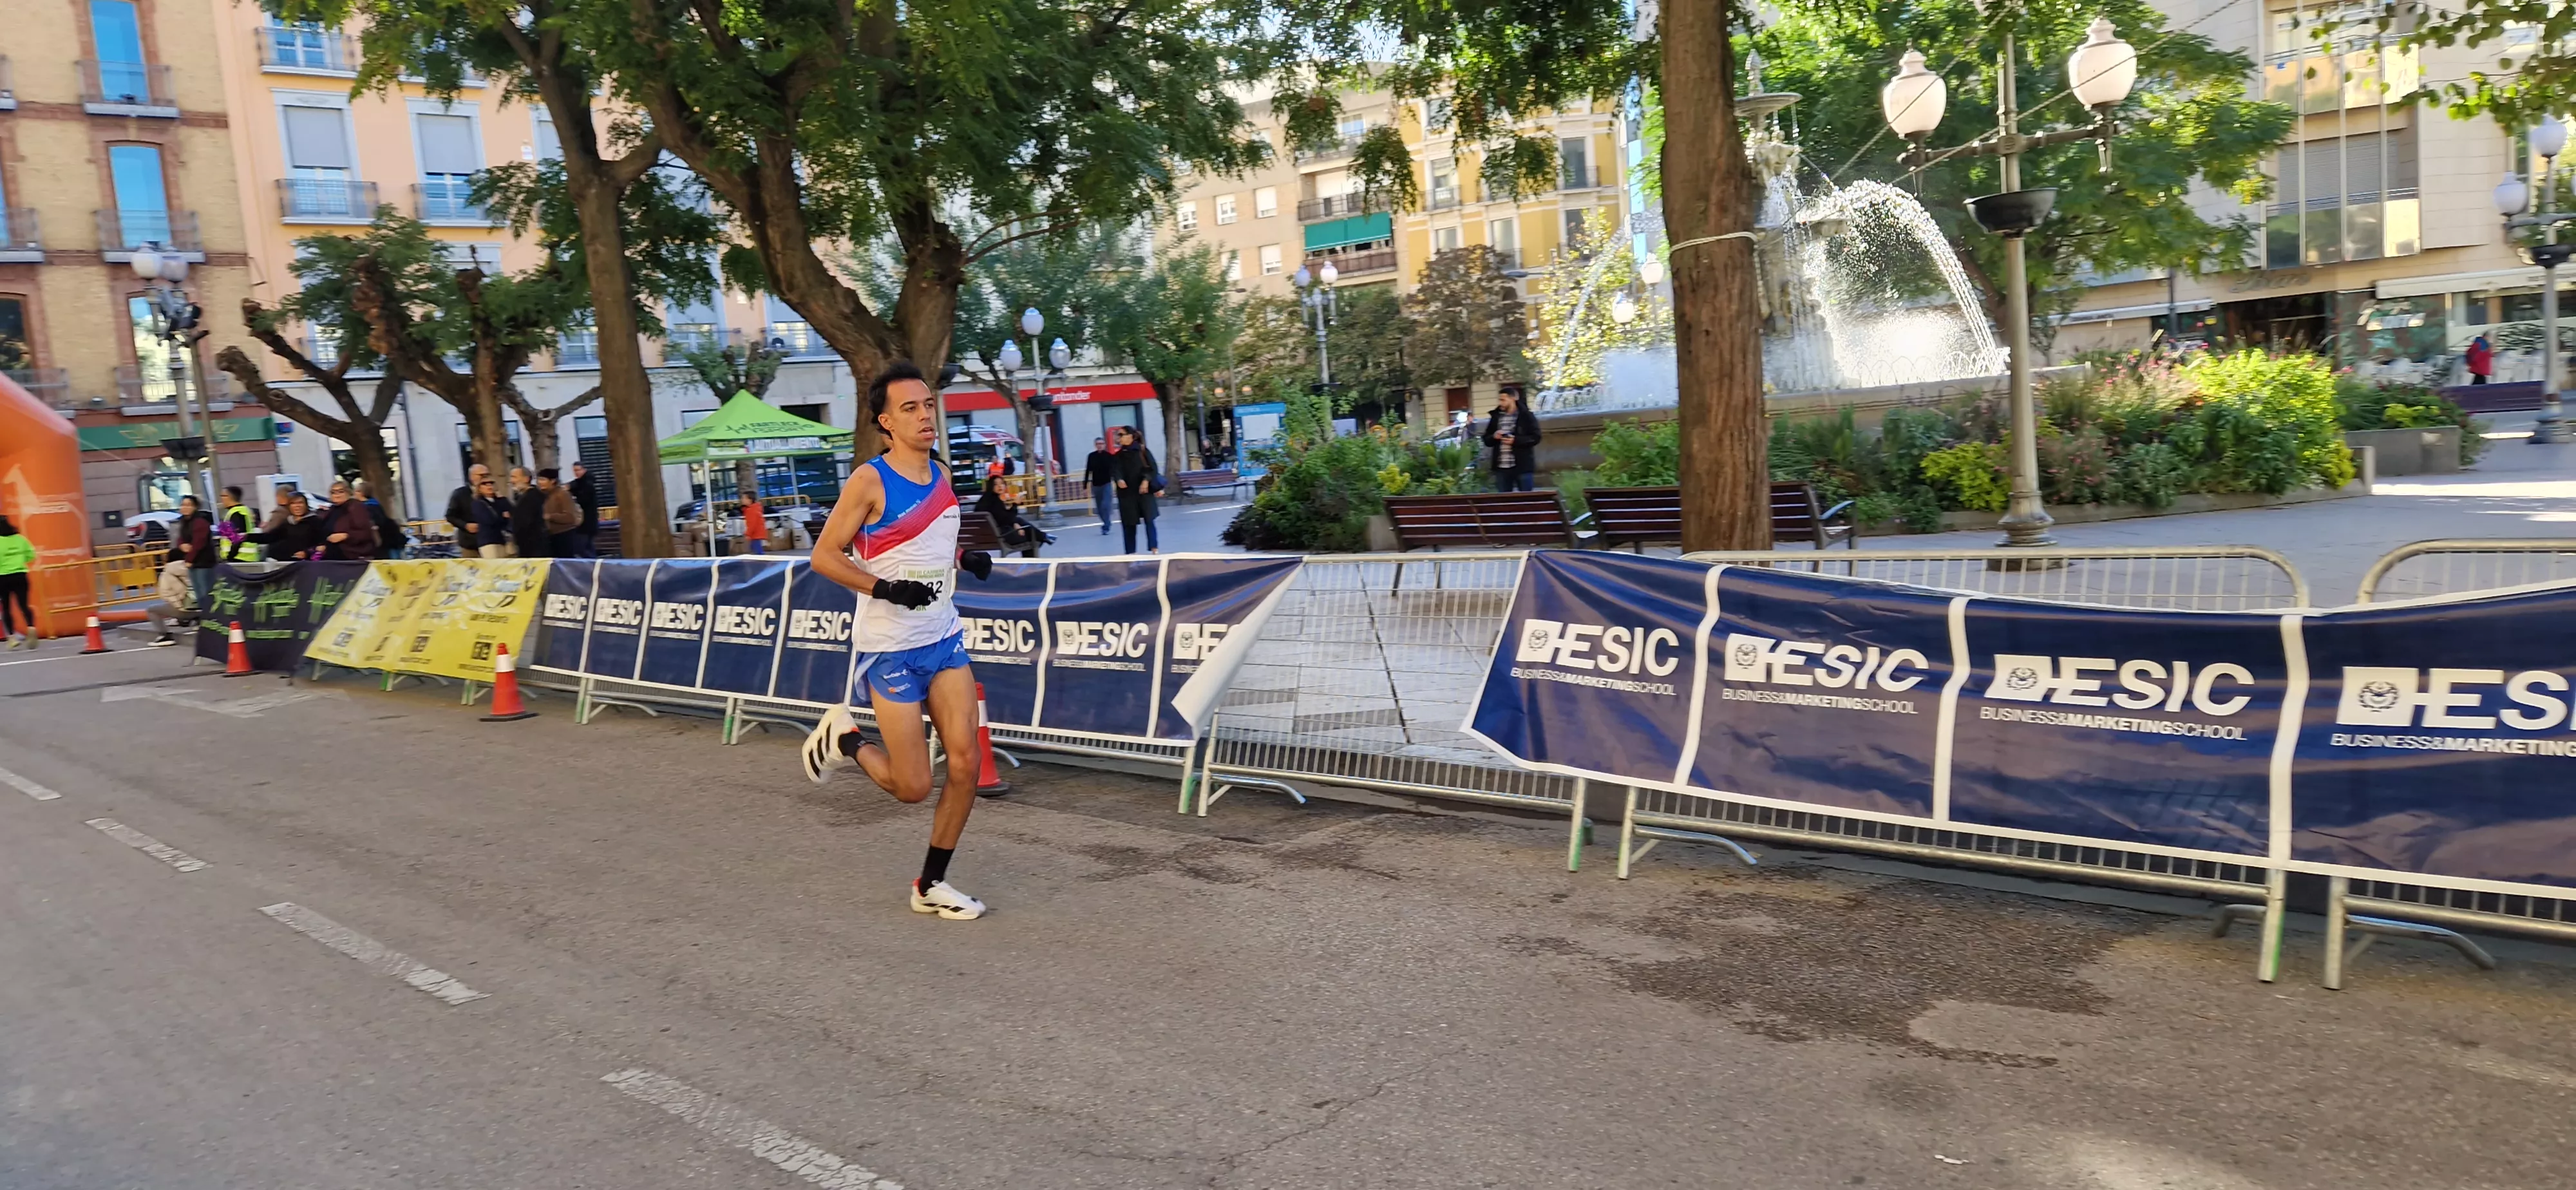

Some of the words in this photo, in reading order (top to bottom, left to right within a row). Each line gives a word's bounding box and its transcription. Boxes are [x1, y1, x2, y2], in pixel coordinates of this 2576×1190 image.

[554, 594, 587, 620] ESIC
[605, 599, 643, 625] ESIC
[663, 603, 704, 630] ESIC
[728, 607, 776, 636] ESIC
[803, 610, 851, 641] ESIC
[972, 618, 1035, 653] ESIC
[1078, 621, 1149, 659] ESIC
[1555, 623, 1680, 677] ESIC
[1770, 640, 1929, 692] ESIC
[2049, 656, 2255, 716] ESIC
